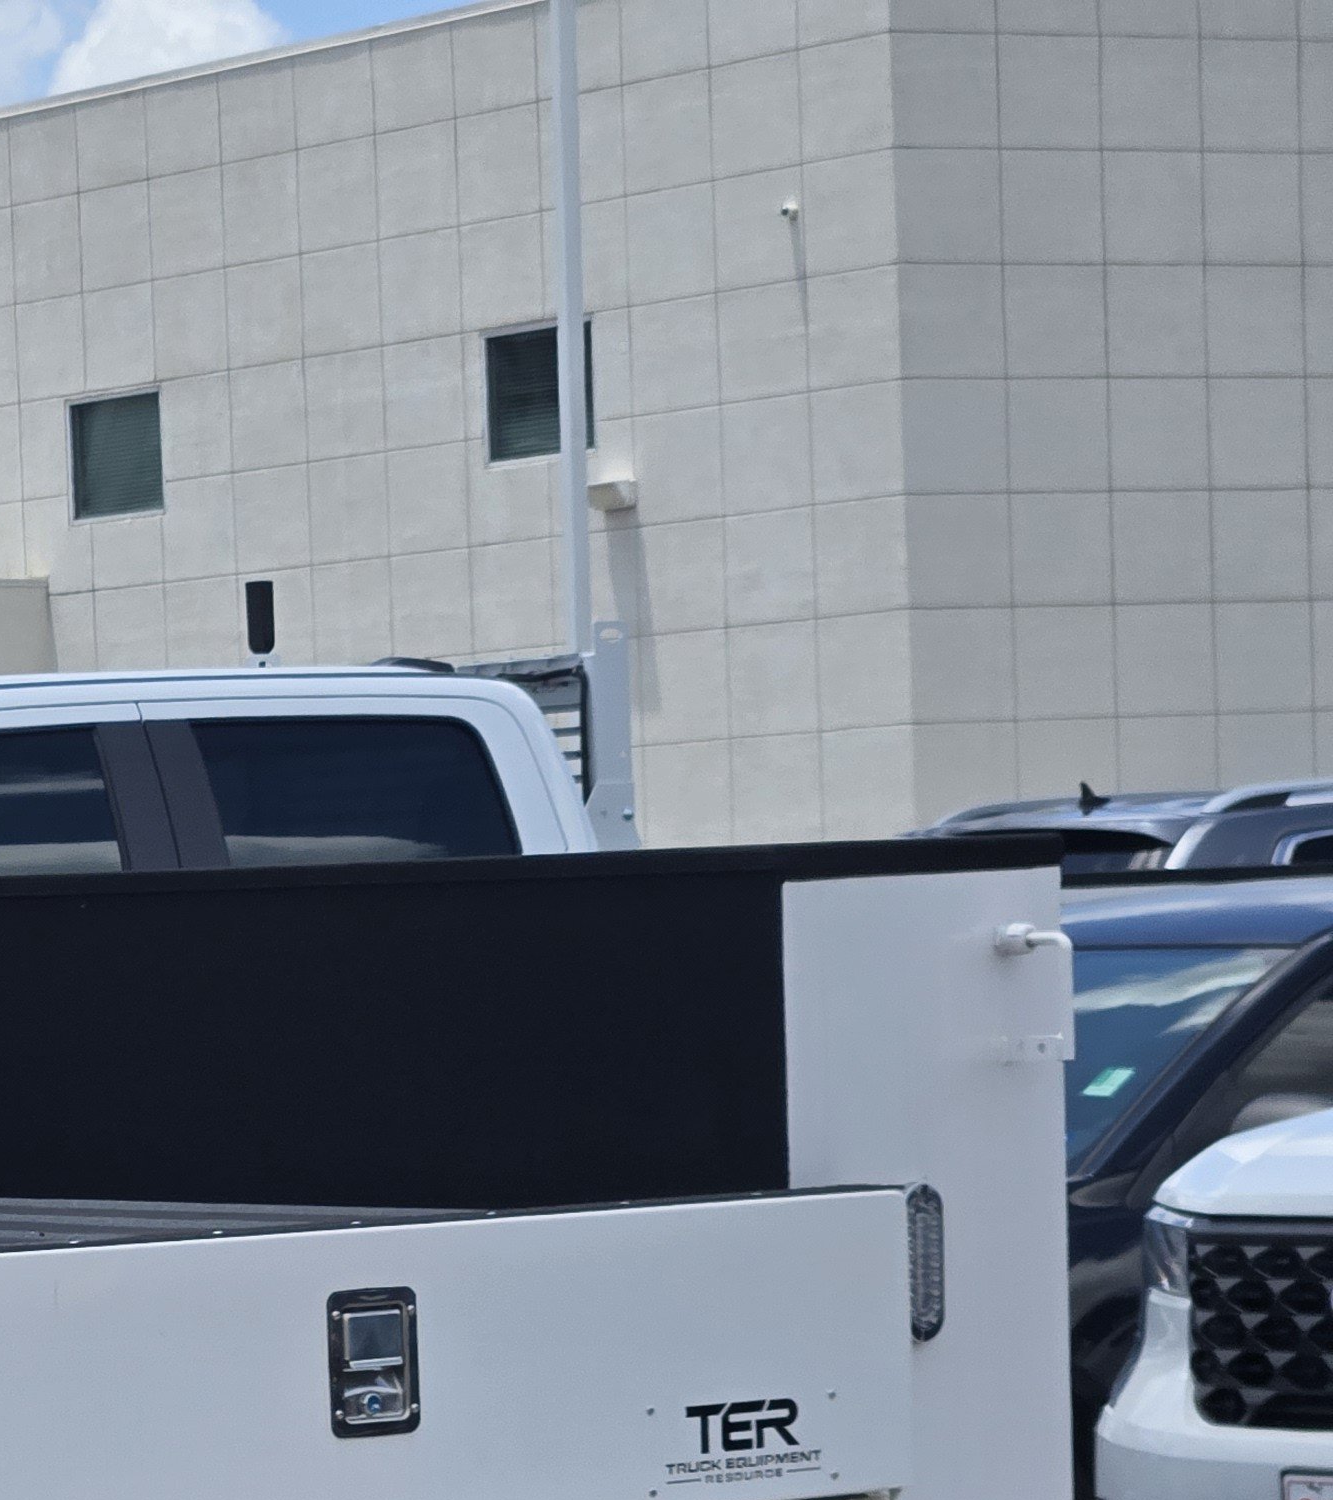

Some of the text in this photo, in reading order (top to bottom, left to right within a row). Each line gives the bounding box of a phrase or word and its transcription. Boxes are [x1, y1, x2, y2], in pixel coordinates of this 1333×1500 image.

[685, 1398, 800, 1454] TER
[665, 1449, 822, 1475] TRUCK EQUIPMENT
[704, 1468, 783, 1484] RESOURCE
